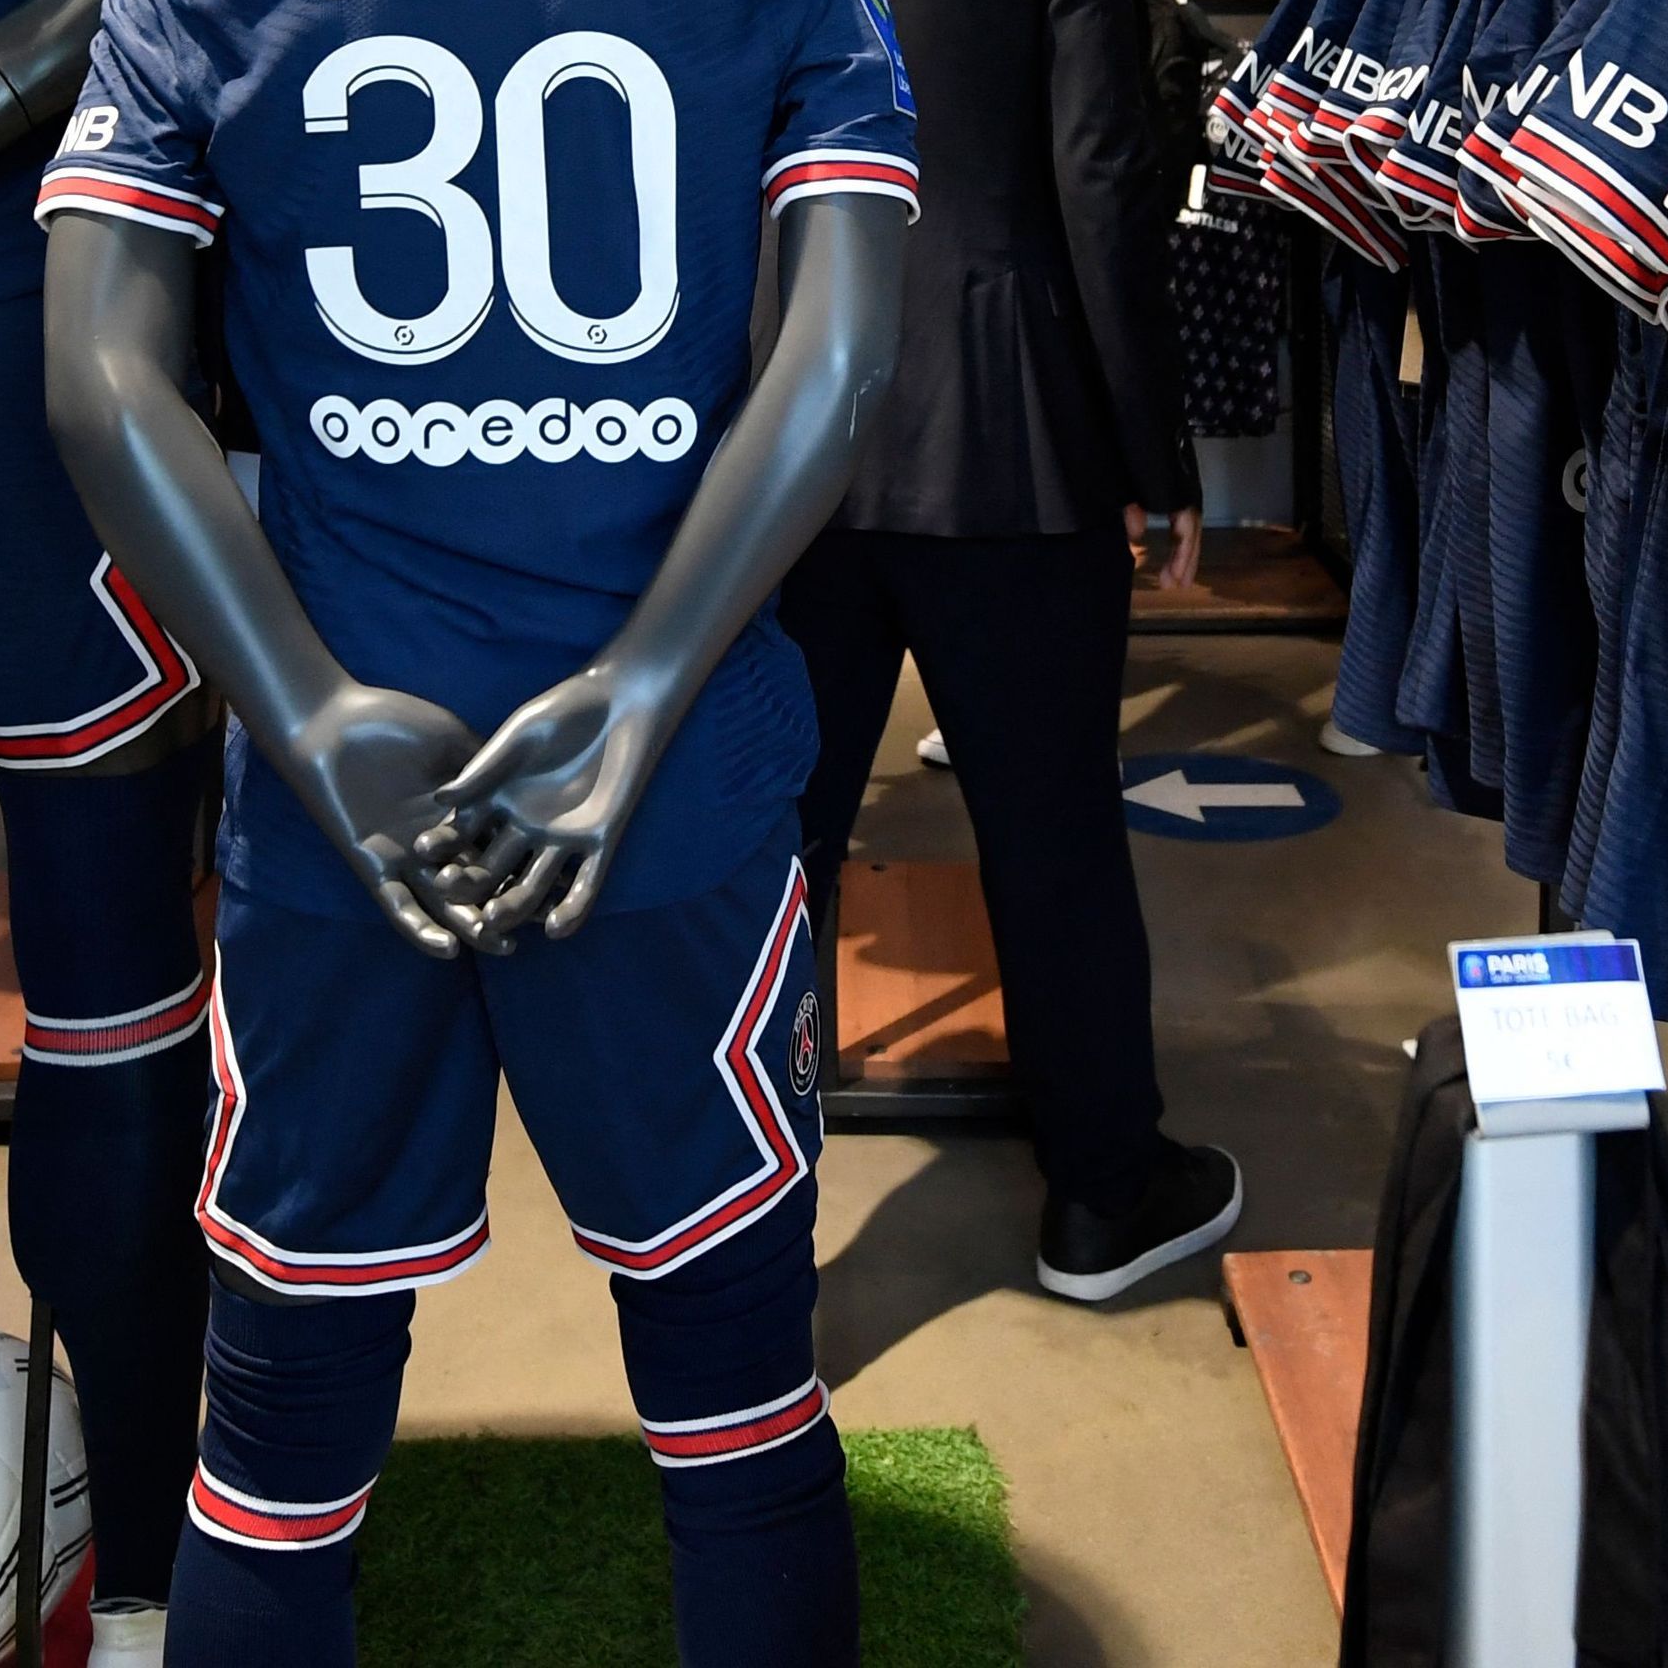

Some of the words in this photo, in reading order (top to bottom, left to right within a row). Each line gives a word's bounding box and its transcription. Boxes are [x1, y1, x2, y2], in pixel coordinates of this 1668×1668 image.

[54, 105, 120, 160] NB
[1568, 49, 1668, 149] NB
[304, 30, 681, 366] 30
[309, 395, 698, 467] ooredoo
[1487, 953, 1549, 973] PARIS
